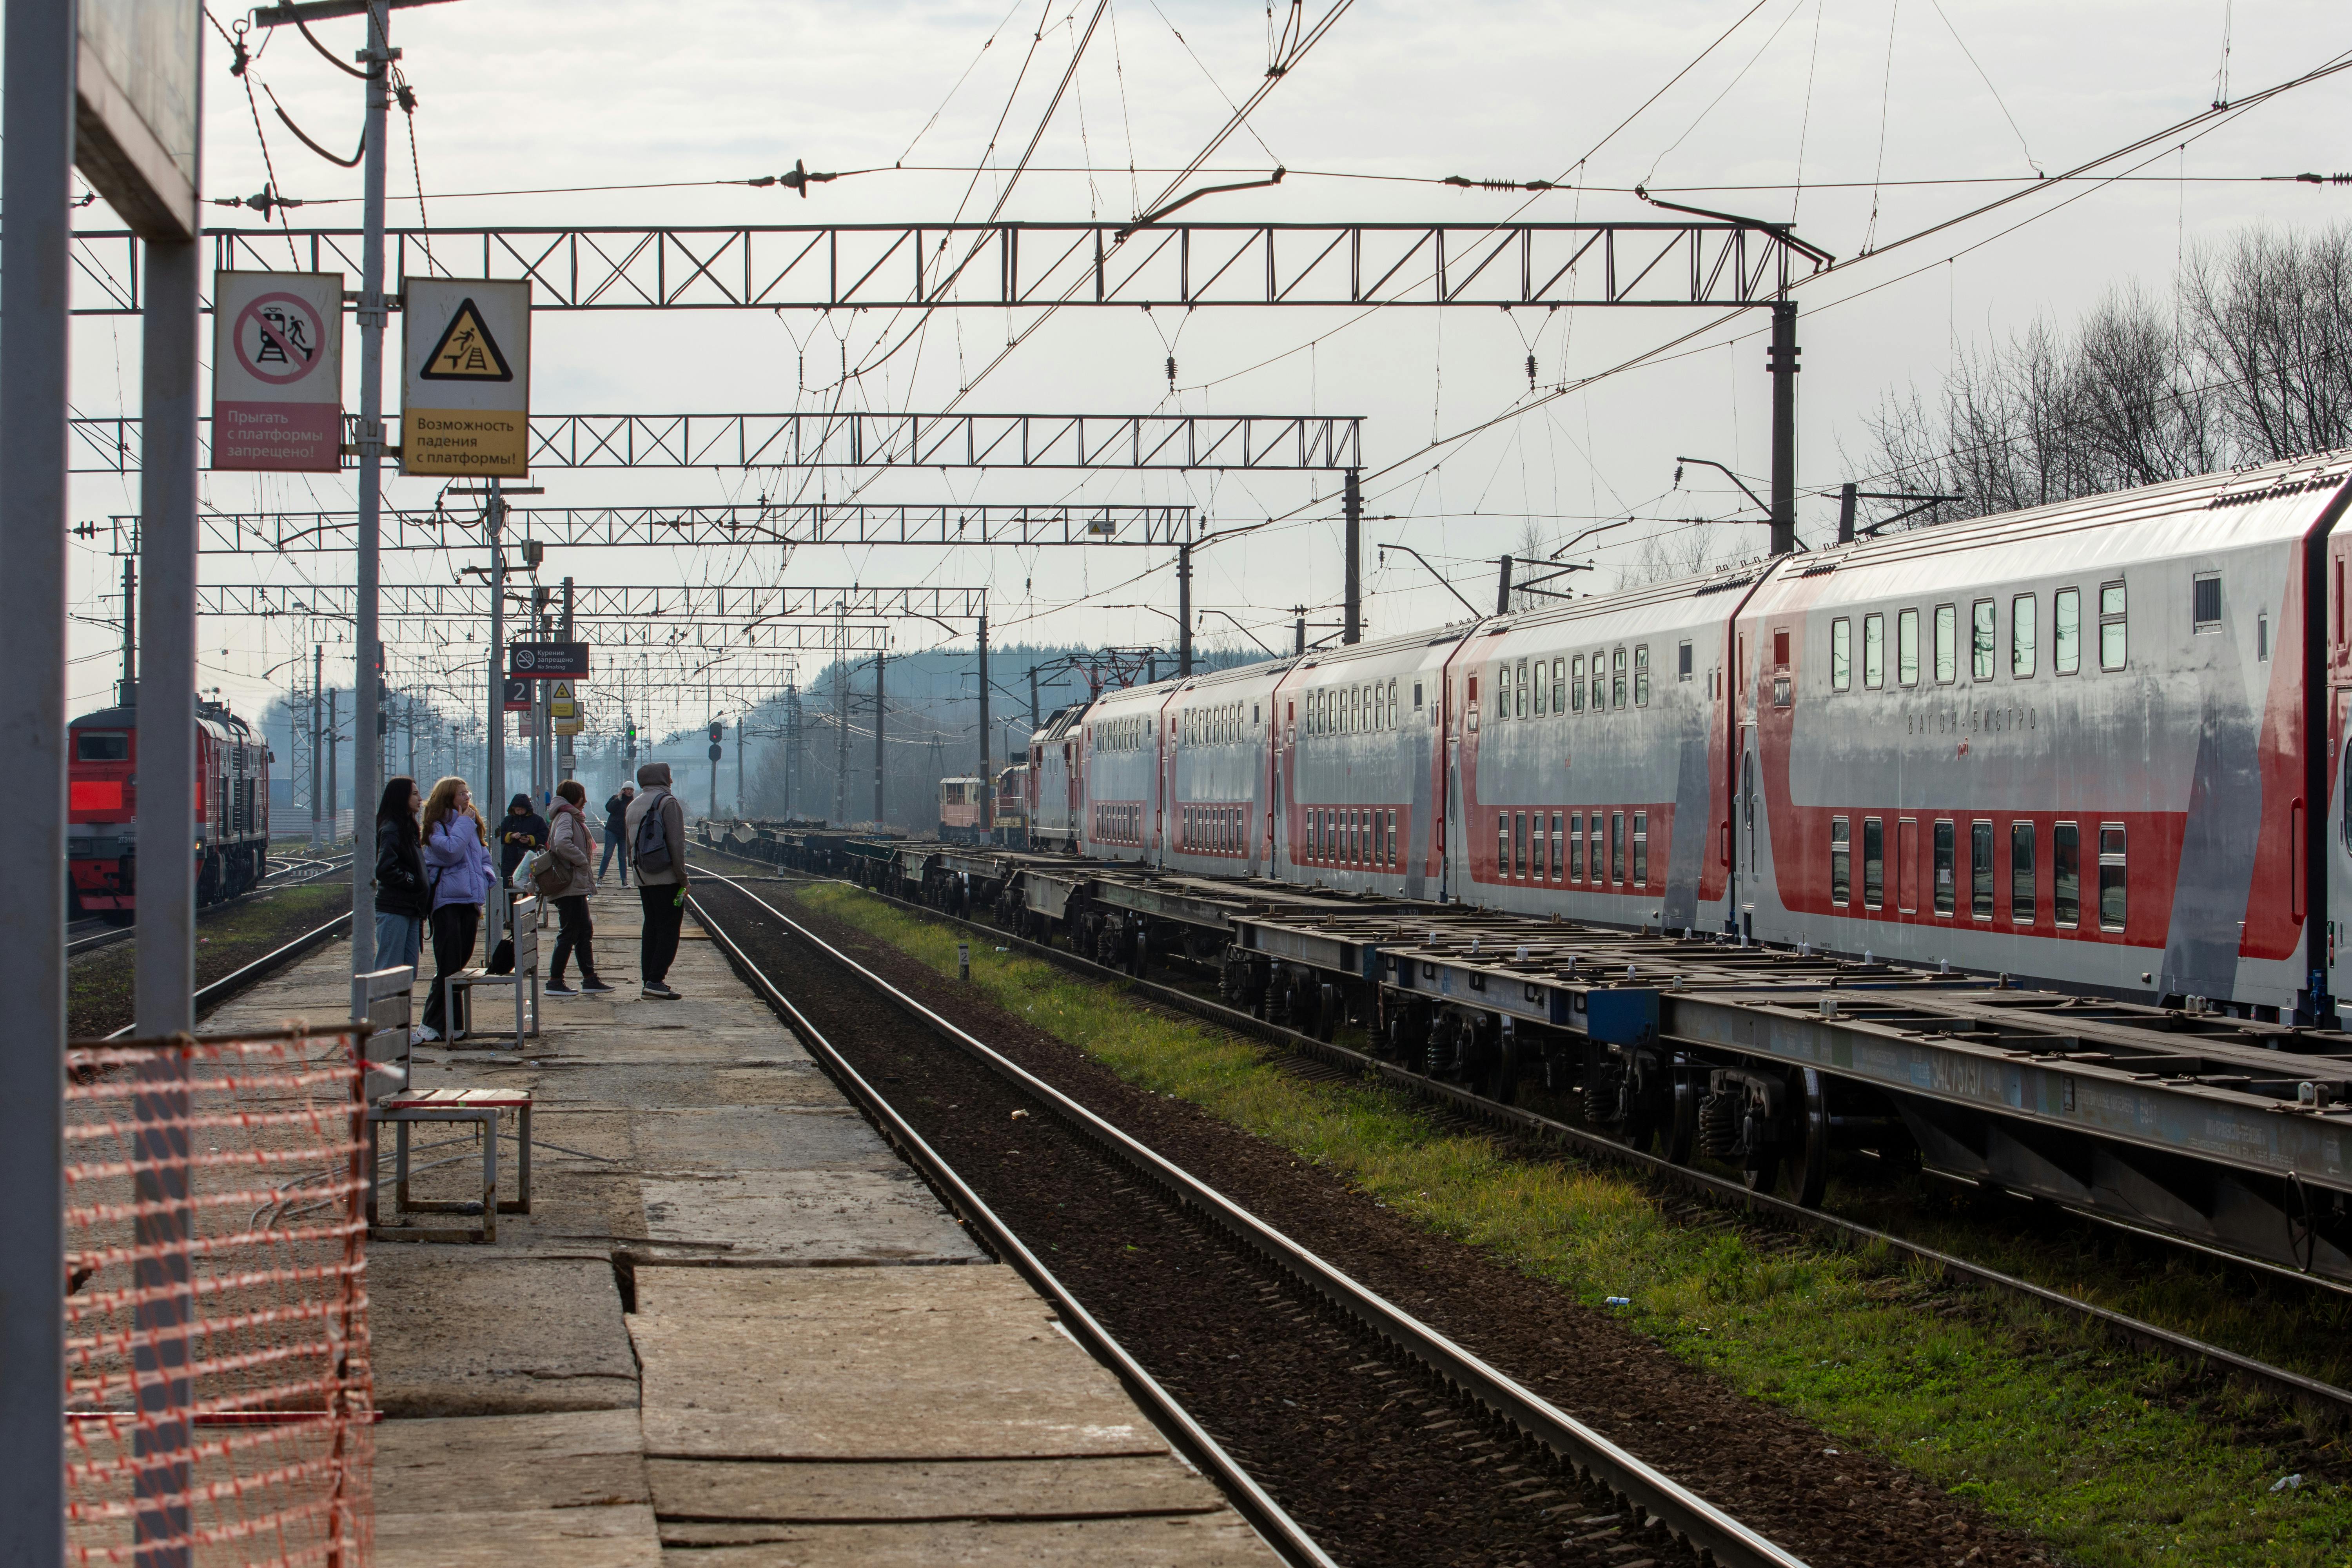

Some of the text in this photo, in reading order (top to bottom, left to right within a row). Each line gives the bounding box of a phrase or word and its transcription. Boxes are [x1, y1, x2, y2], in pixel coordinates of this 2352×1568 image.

[228, 410, 288, 425] Прыгать
[418, 418, 514, 432] Возможность
[227, 427, 323, 444] с платформы
[417, 437, 477, 449] падения
[227, 445, 314, 459] запрещено!
[417, 452, 516, 466] с платформы!
[514, 682, 525, 700] 2
[1908, 706, 2036, 735] ВАГОН-БИСТРО
[1940, 869, 1950, 884] 00003
